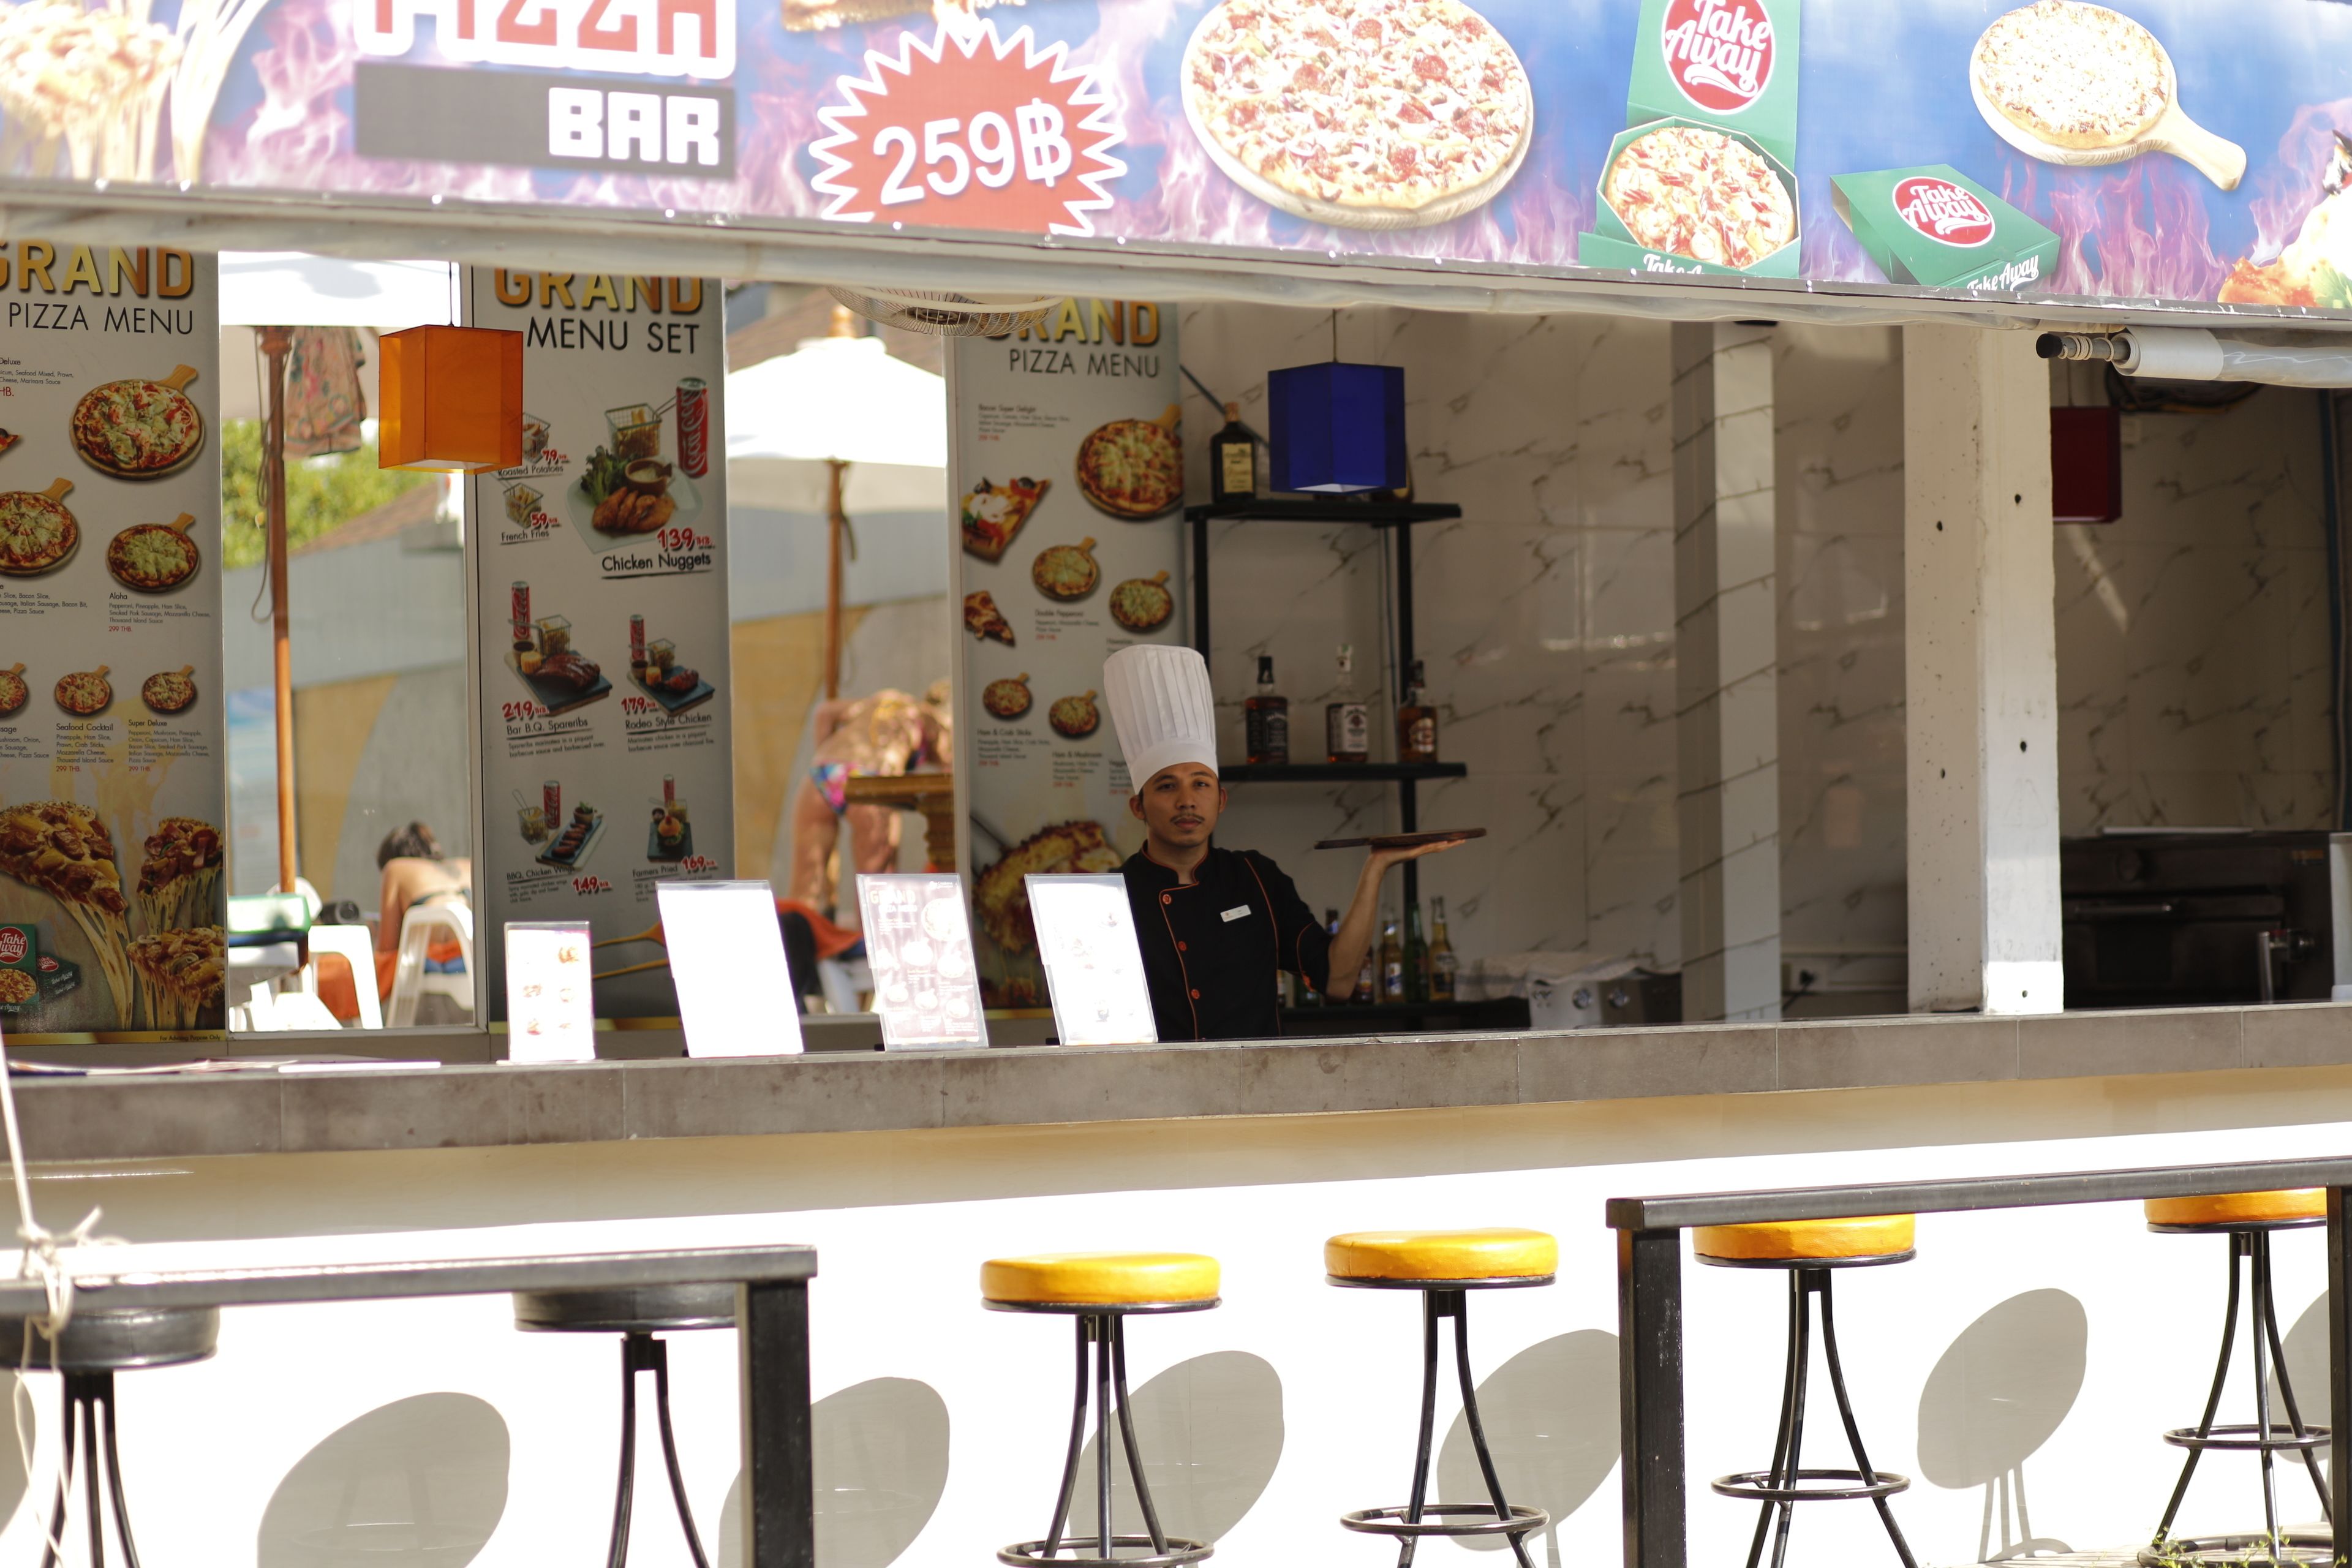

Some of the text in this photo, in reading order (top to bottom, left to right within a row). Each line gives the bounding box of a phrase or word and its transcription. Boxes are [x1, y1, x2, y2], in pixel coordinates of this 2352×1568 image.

[1694, 0, 1771, 51] Take
[1664, 19, 1763, 93] Away
[549, 87, 720, 165] BAR
[1910, 184, 1969, 206] Take
[1902, 198, 1991, 229] Away
[1999, 255, 2039, 292] Away
[9, 303, 193, 335] PIZZA MENU
[984, 296, 1159, 345] AND
[527, 317, 700, 354] MENU SET
[1009, 349, 1159, 378] PIZZA MENU
[541, 449, 559, 462] 79
[497, 464, 564, 477] Roasted Potatoes
[531, 513, 548, 527] 59
[501, 528, 549, 542] French Fries
[657, 527, 693, 549] 139
[601, 552, 711, 571] Chicken Nuggets
[502, 700, 533, 718] 219
[621, 696, 646, 712] 179
[128, 719, 145, 728] Super
[507, 717, 588, 736] Bar B.Q. Spareribs
[625, 711, 712, 731] Rodeo Style Chicken
[682, 855, 705, 870] 169
[507, 871, 524, 881] BBQ,
[526, 867, 552, 878] Chicken
[632, 867, 659, 878] Farmers
[572, 876, 598, 892] 149
[1, 933, 26, 945] Take
